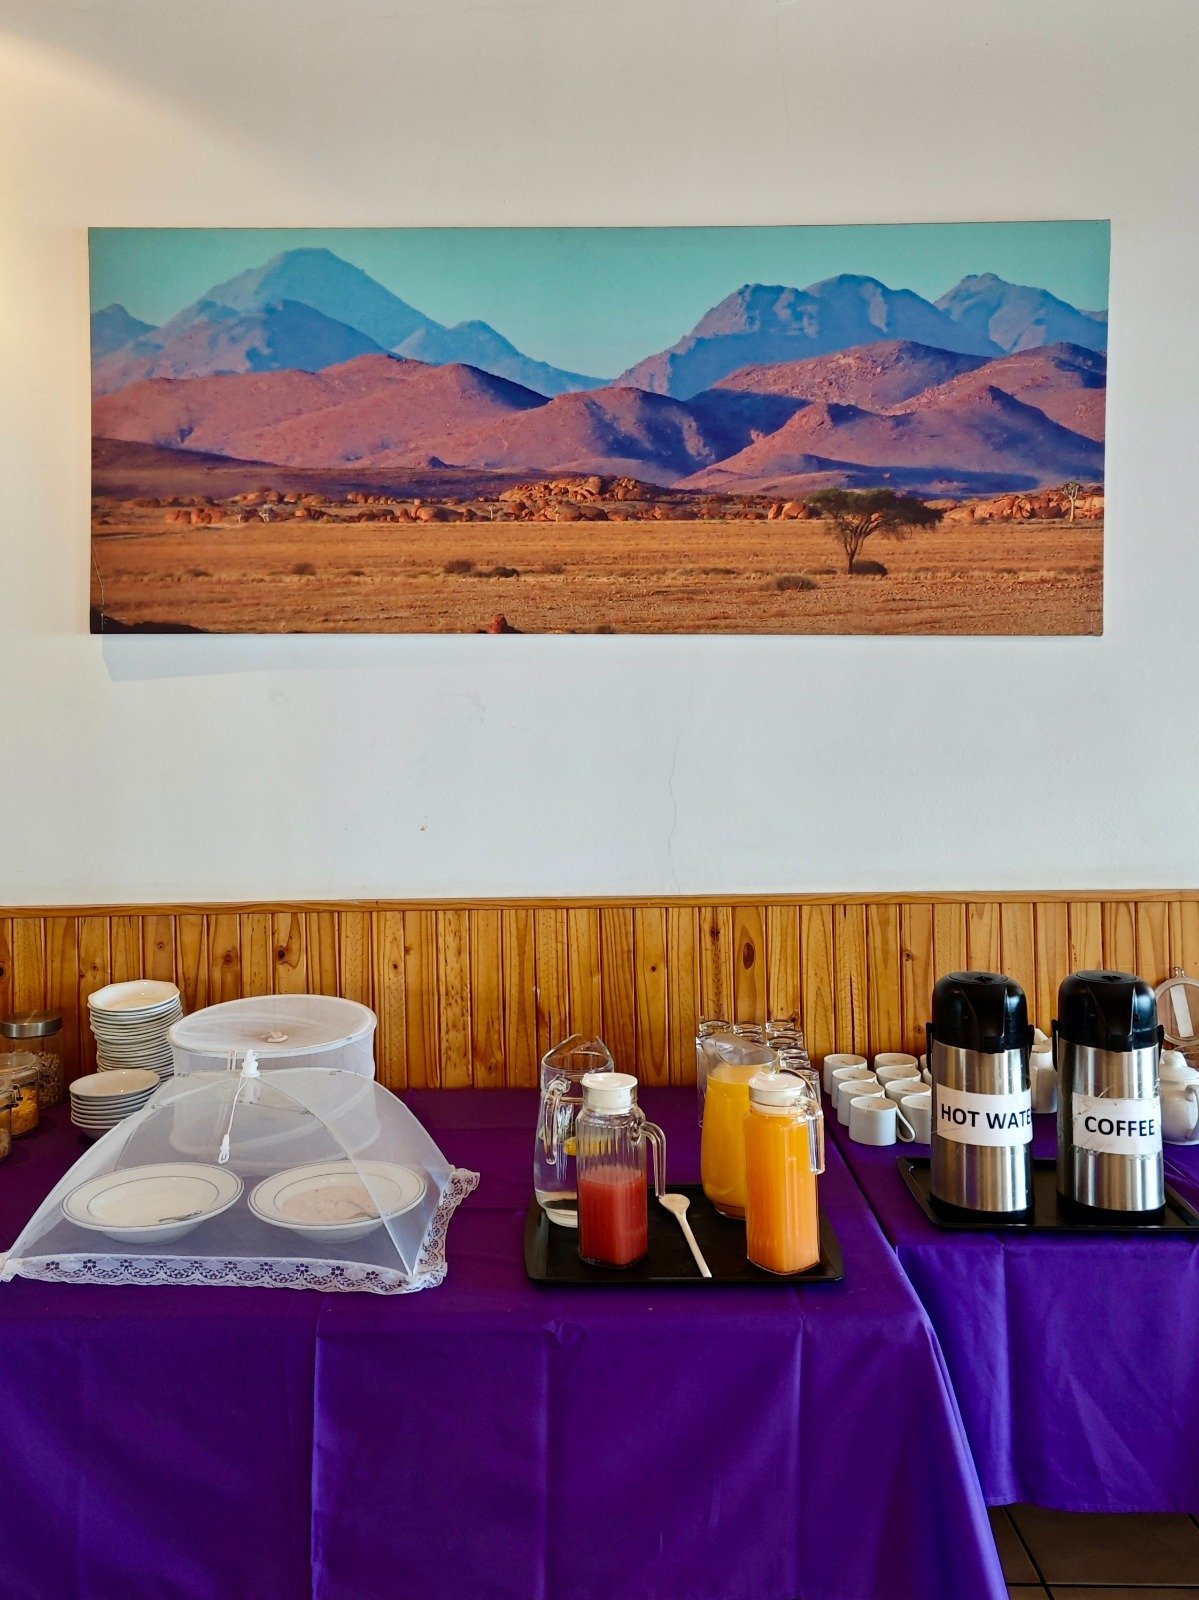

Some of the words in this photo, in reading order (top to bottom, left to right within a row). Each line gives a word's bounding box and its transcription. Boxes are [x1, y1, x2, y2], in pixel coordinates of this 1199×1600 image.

[941, 1103, 980, 1127] HOT
[985, 1108, 1031, 1129] WATE
[1084, 1115, 1155, 1137] COFFEE
